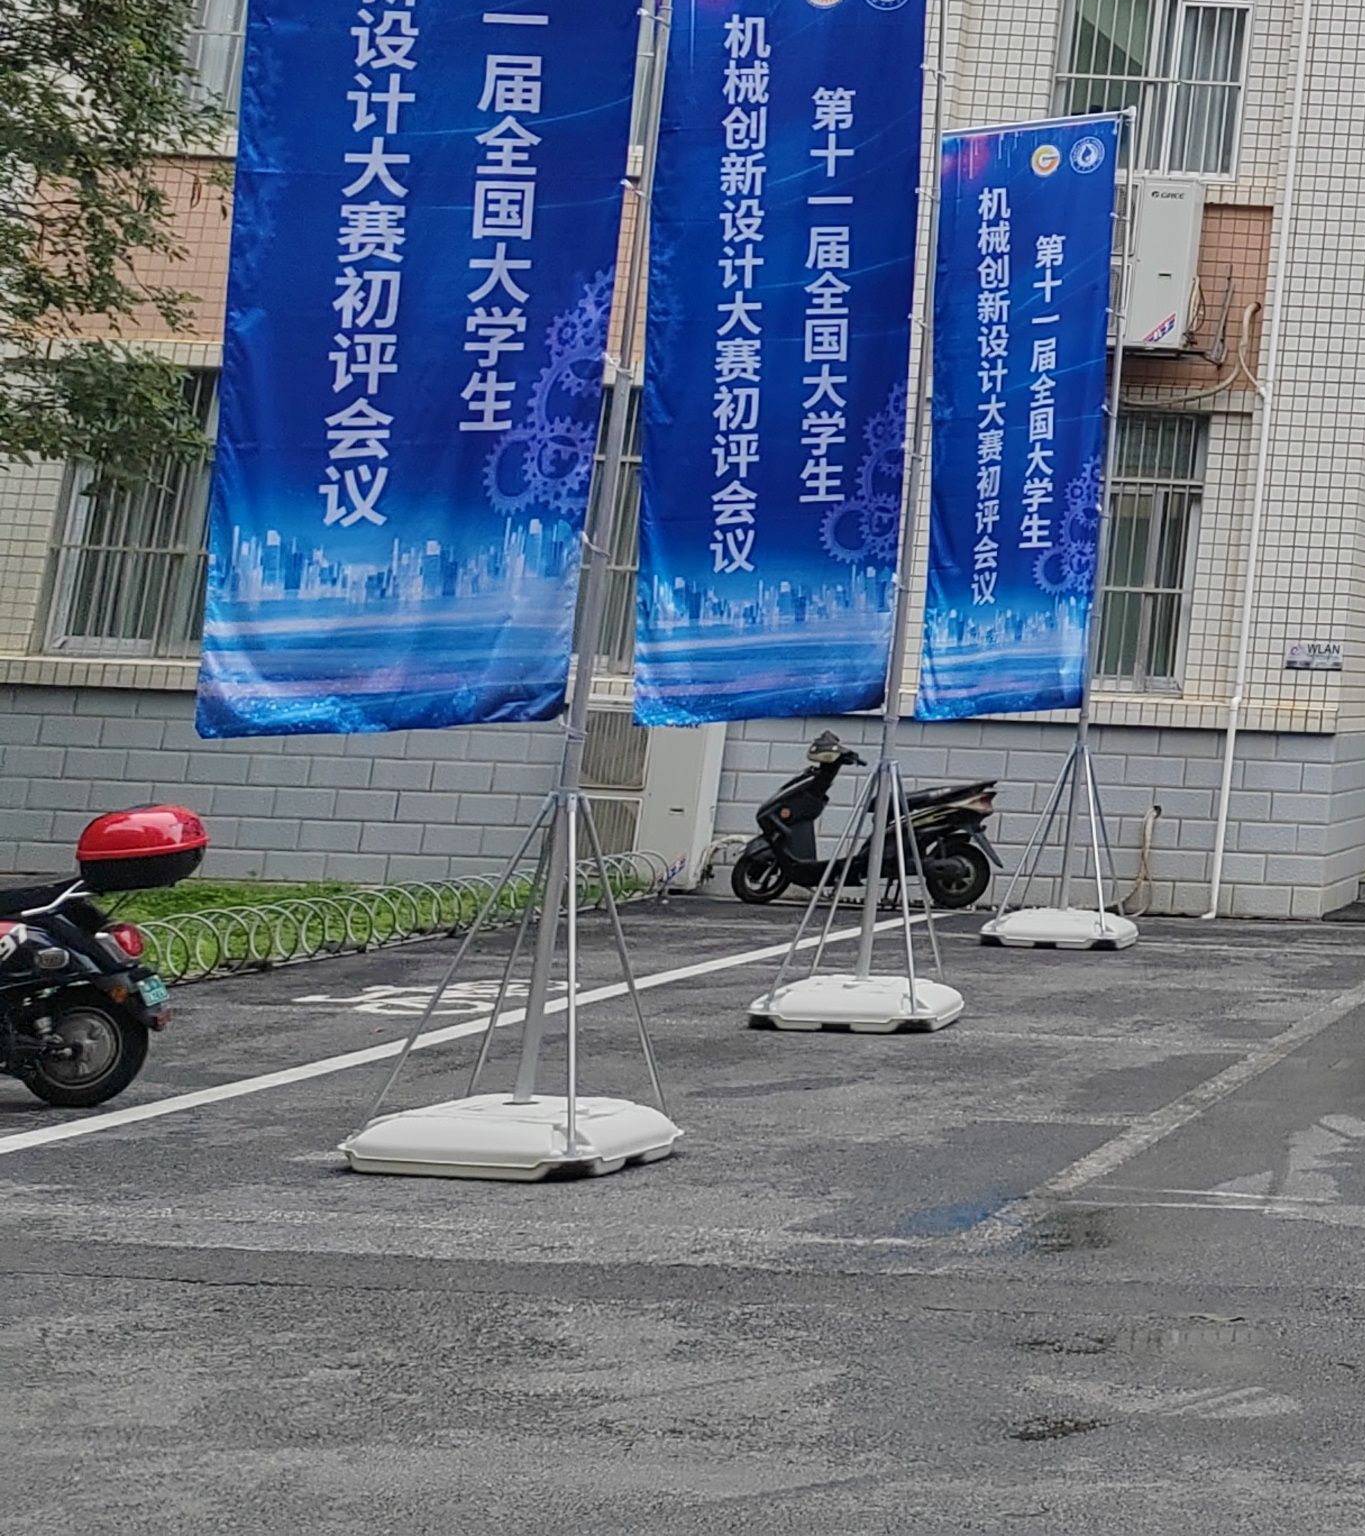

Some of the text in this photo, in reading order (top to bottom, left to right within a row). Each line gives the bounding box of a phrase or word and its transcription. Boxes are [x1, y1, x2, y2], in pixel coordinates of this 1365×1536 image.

[709, 13, 772, 573] 机械创新设计大赛初评会议
[799, 86, 857, 503] 第十一届全国大学生
[971, 187, 1011, 606] 机械创新设计大赛初评会议
[1018, 233, 1066, 549] 第十一届全国大学生
[1307, 643, 1341, 655] WLAN
